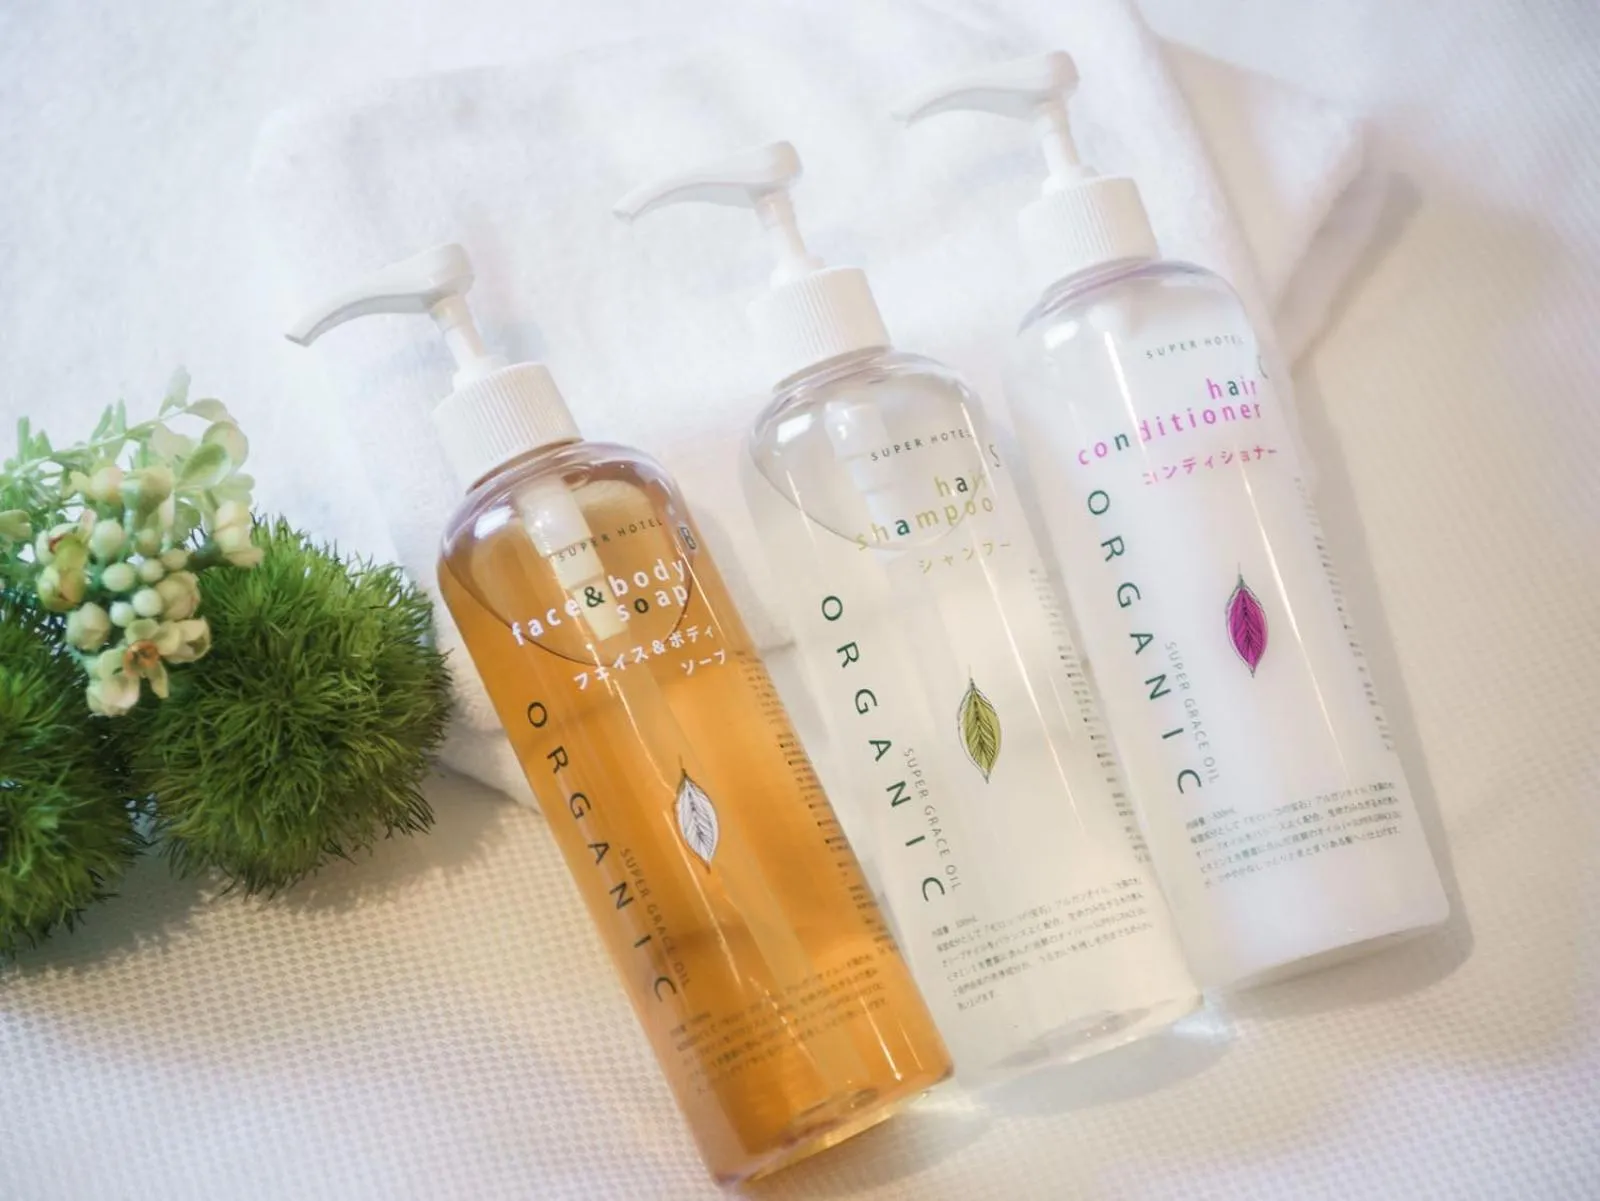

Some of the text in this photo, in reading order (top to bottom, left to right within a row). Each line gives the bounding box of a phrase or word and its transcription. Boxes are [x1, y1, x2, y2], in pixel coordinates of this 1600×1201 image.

[1146, 340, 1197, 359] SUPER
[1206, 376, 1257, 400] hair
[871, 428, 973, 461] SUPER HOTEL
[1078, 402, 1261, 465] conditioner
[934, 470, 988, 497] hair
[1142, 444, 1278, 485] コンディショナー
[558, 517, 663, 562] SUPER HOTEL
[855, 497, 994, 552] shampoo
[511, 557, 686, 646] face & body
[616, 584, 688, 622] soap
[1087, 490, 1202, 794] ORGANIC
[1165, 641, 1220, 784] SUPER GRACE OIL
[821, 596, 945, 902] ORGANIC
[903, 747, 961, 891] SUPER GRACE OIL
[526, 702, 679, 1003] ORGANIC
[620, 847, 651, 901] SUPER
